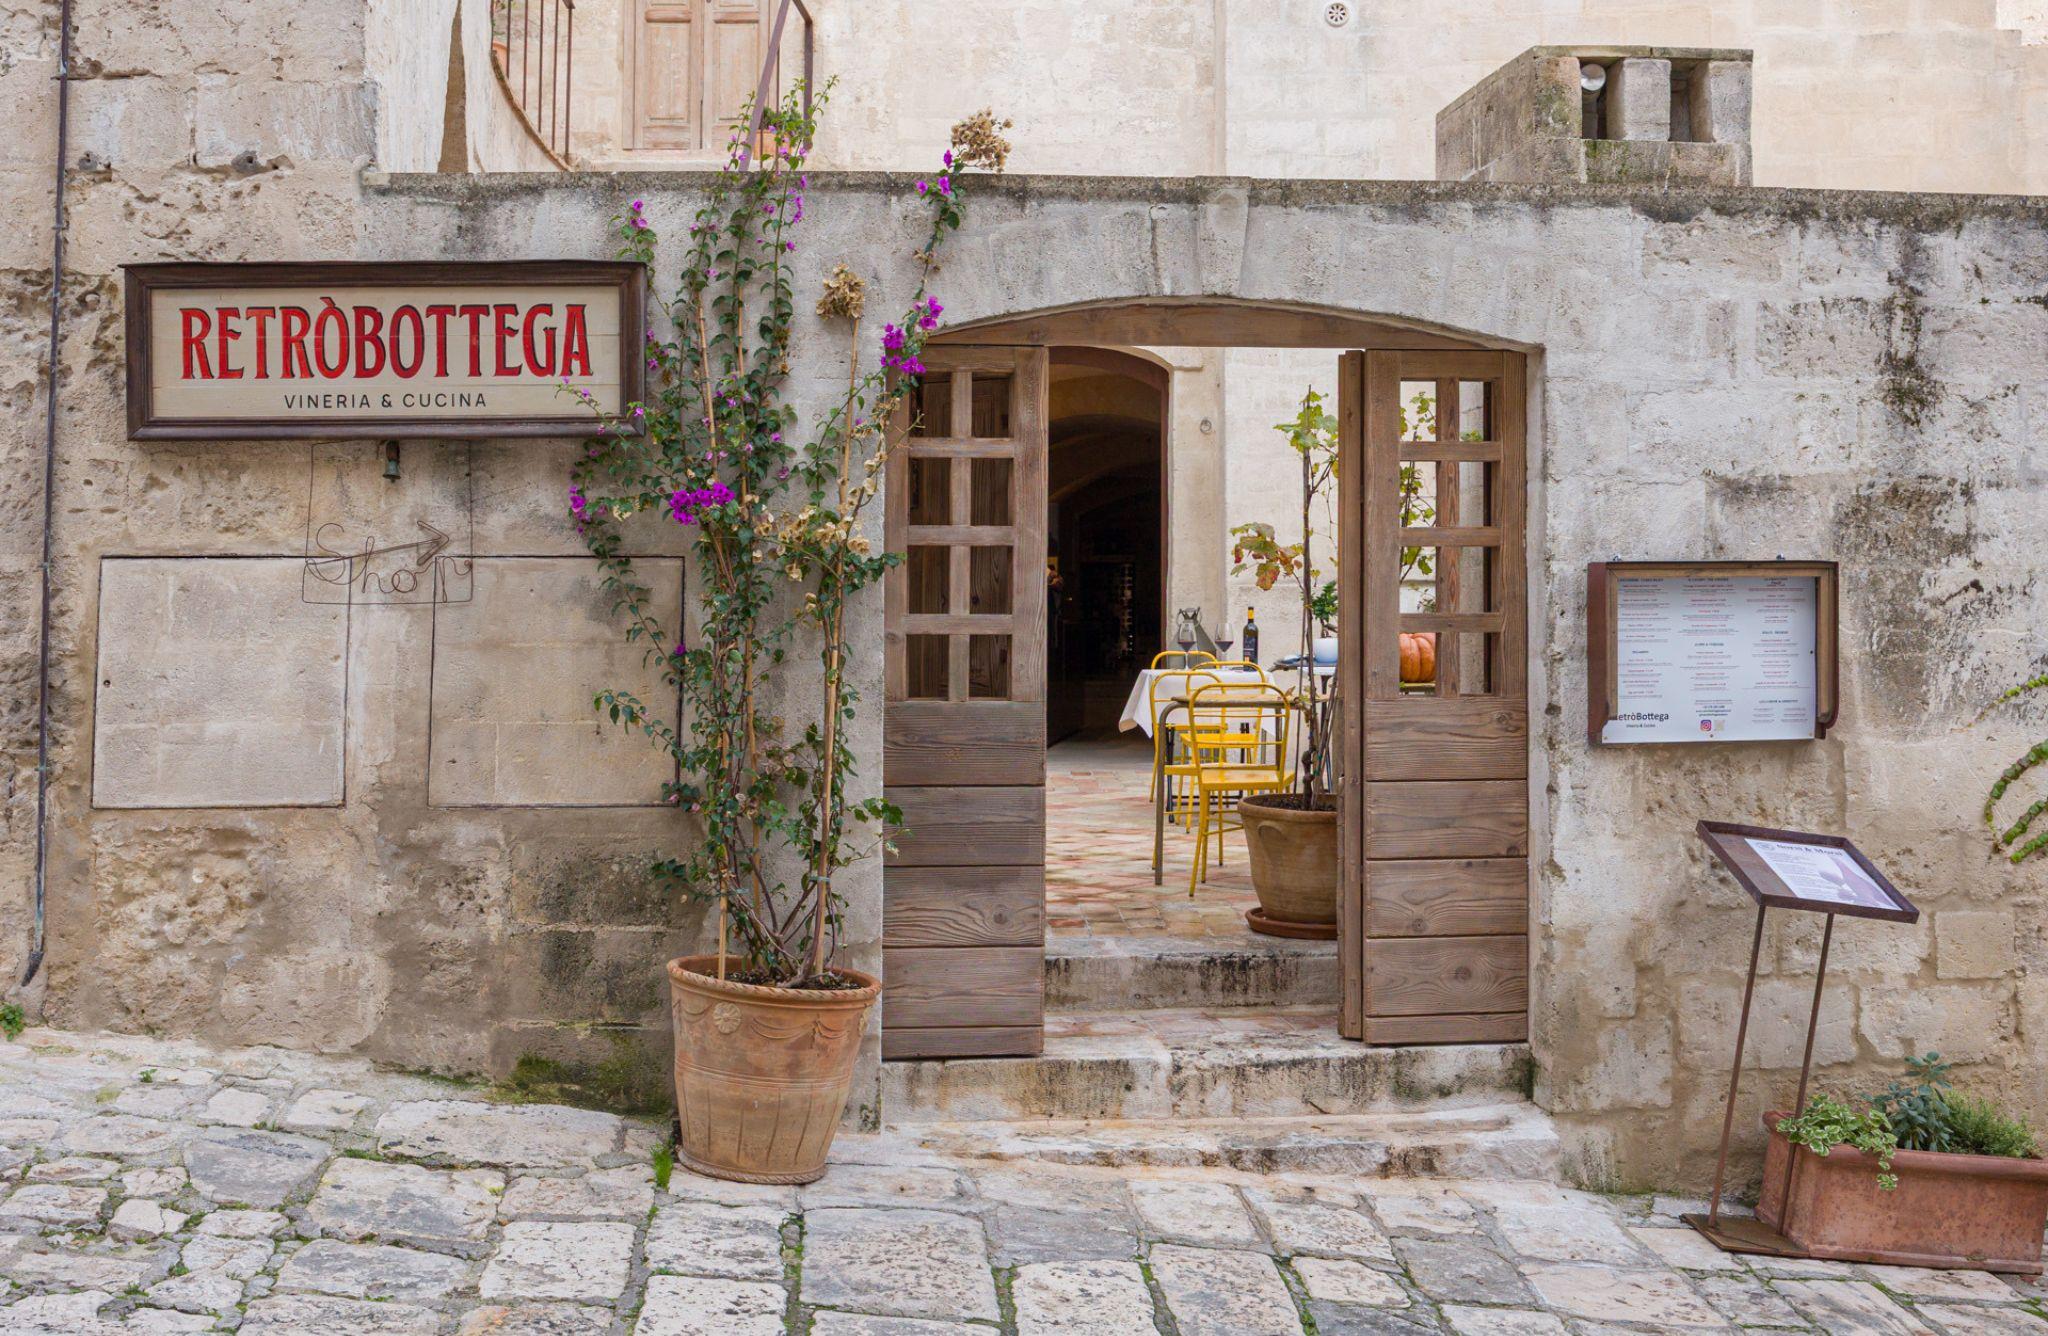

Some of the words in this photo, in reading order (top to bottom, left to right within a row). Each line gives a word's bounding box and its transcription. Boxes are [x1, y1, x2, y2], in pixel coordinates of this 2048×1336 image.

[179, 296, 594, 379] RETRÒBOTTEGA
[284, 394, 371, 409] VINERIA
[381, 393, 394, 408] &
[403, 392, 487, 408] CUCINA
[305, 523, 473, 603] Shop
[1618, 712, 1669, 721] etròBottega
